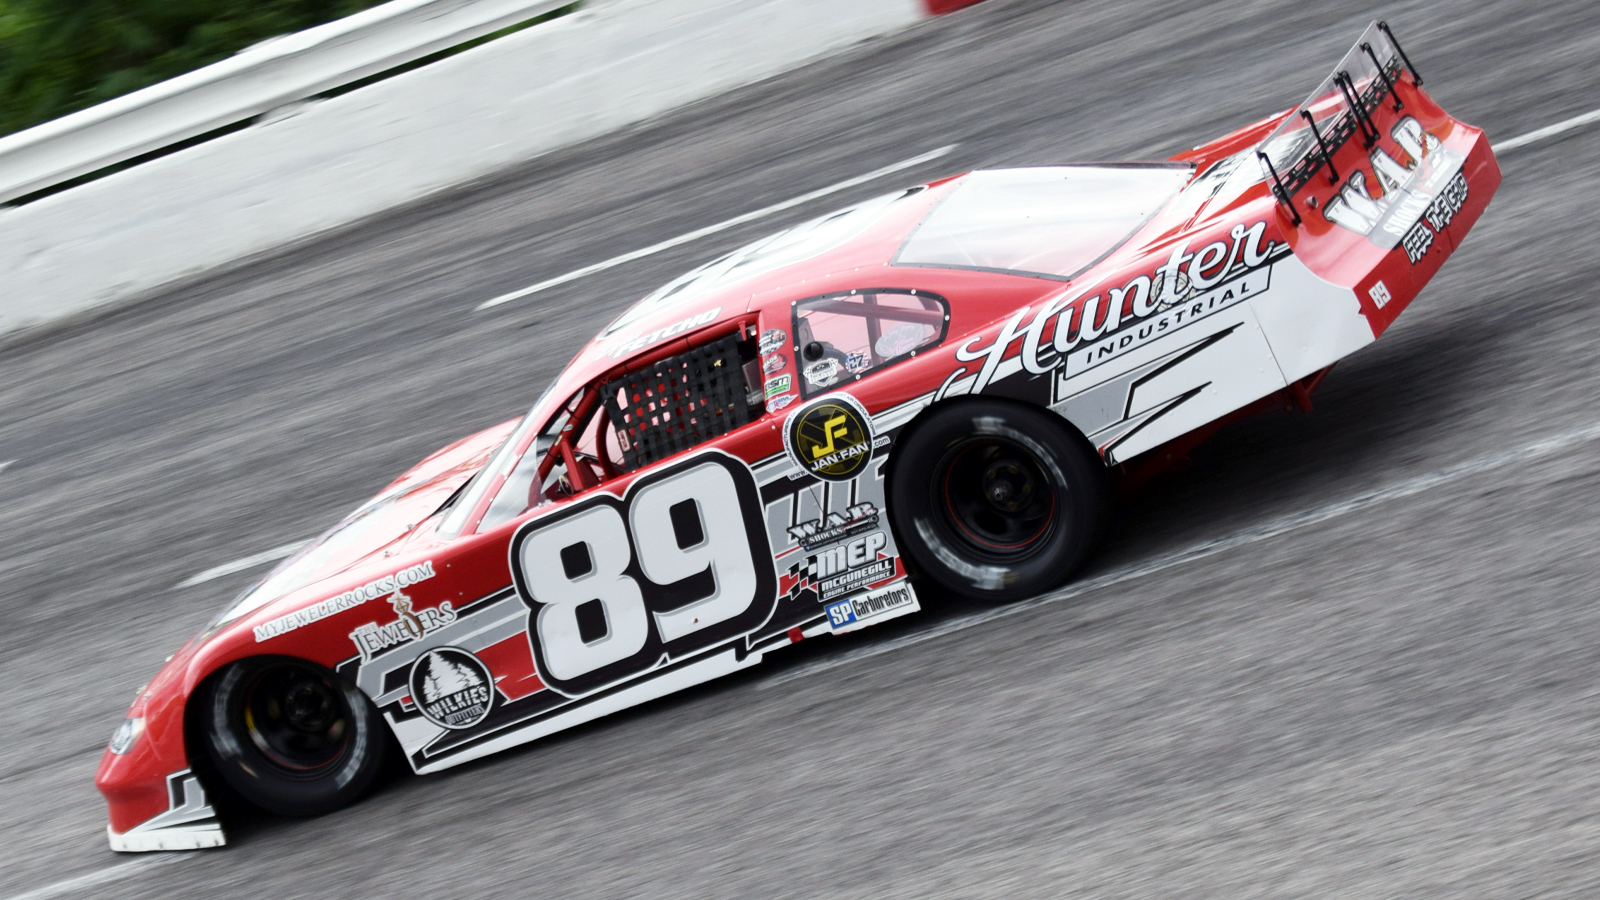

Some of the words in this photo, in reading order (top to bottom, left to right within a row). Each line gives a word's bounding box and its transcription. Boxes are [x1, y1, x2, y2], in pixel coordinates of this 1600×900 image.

[1382, 188, 1433, 236] SHOCKS
[1402, 221, 1434, 264] FEEL
[932, 221, 1275, 402] Hunter
[1368, 280, 1392, 309] 89
[612, 307, 722, 359] FETCHO
[1086, 282, 1250, 364] INDUSTRIAL
[848, 355, 864, 370] 27
[809, 528, 844, 543] SHOCKS
[816, 532, 886, 579] MEP
[519, 461, 757, 681] 89
[821, 561, 892, 592] MCGUNEGILL
[823, 586, 845, 599] ENGINE
[846, 572, 891, 591] PERFORMANCE
[255, 562, 434, 641] MYJEWELERROCKS.COM
[829, 602, 853, 625] SP
[852, 588, 909, 616] Carburetors
[353, 603, 455, 661] JEWELERS
[358, 624, 377, 634] THE
